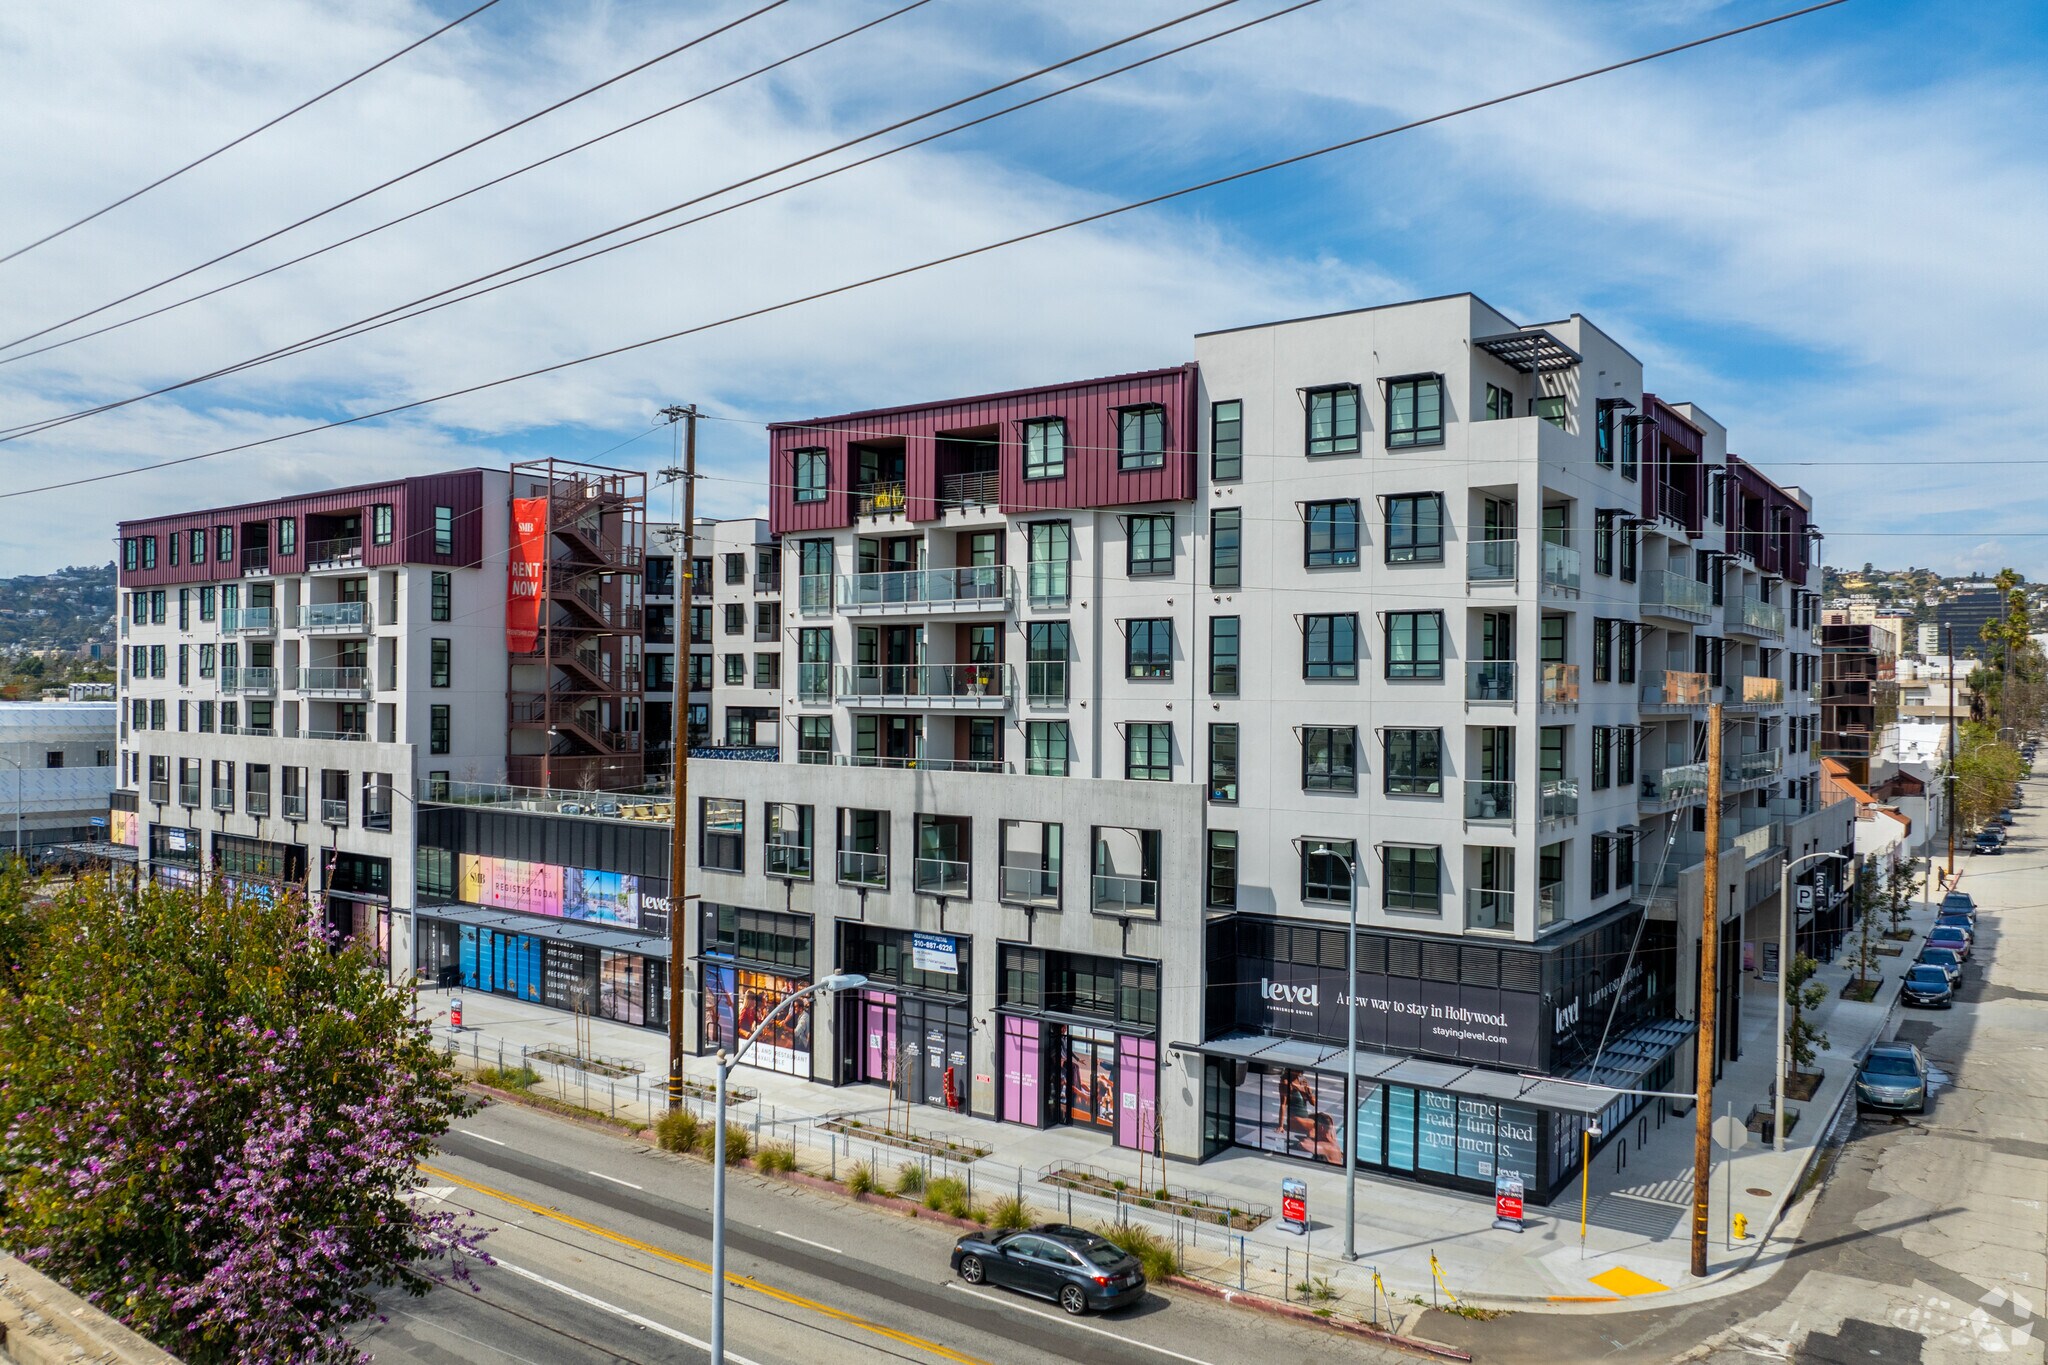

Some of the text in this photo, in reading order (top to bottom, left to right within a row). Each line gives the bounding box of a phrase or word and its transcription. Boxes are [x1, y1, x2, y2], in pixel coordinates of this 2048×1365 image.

[518, 522, 534, 533] SMB
[512, 561, 540, 577] RENT
[512, 580, 538, 596] NOW
[470, 873, 485, 884] SMB
[1816, 872, 1826, 897] level
[495, 883, 558, 898] REGISTER TODAY
[1800, 889, 1810, 903] P
[547, 959, 561, 968] THAT
[547, 981, 567, 990] LUXURY
[1261, 977, 1320, 1007] level
[1336, 992, 1345, 1005] A
[1371, 998, 1392, 1014] way
[1393, 1000, 1405, 1013] to
[1407, 1003, 1429, 1019] stay
[1431, 1004, 1443, 1018] in
[1445, 1005, 1508, 1027] Hollywood.
[1556, 996, 1579, 1034] level
[1432, 1026, 1508, 1044] stayinglevel.com
[1425, 1091, 1504, 1119] Red carpet
[1467, 1117, 1533, 1142] furnished
[1425, 1131, 1513, 1158] apartments.
